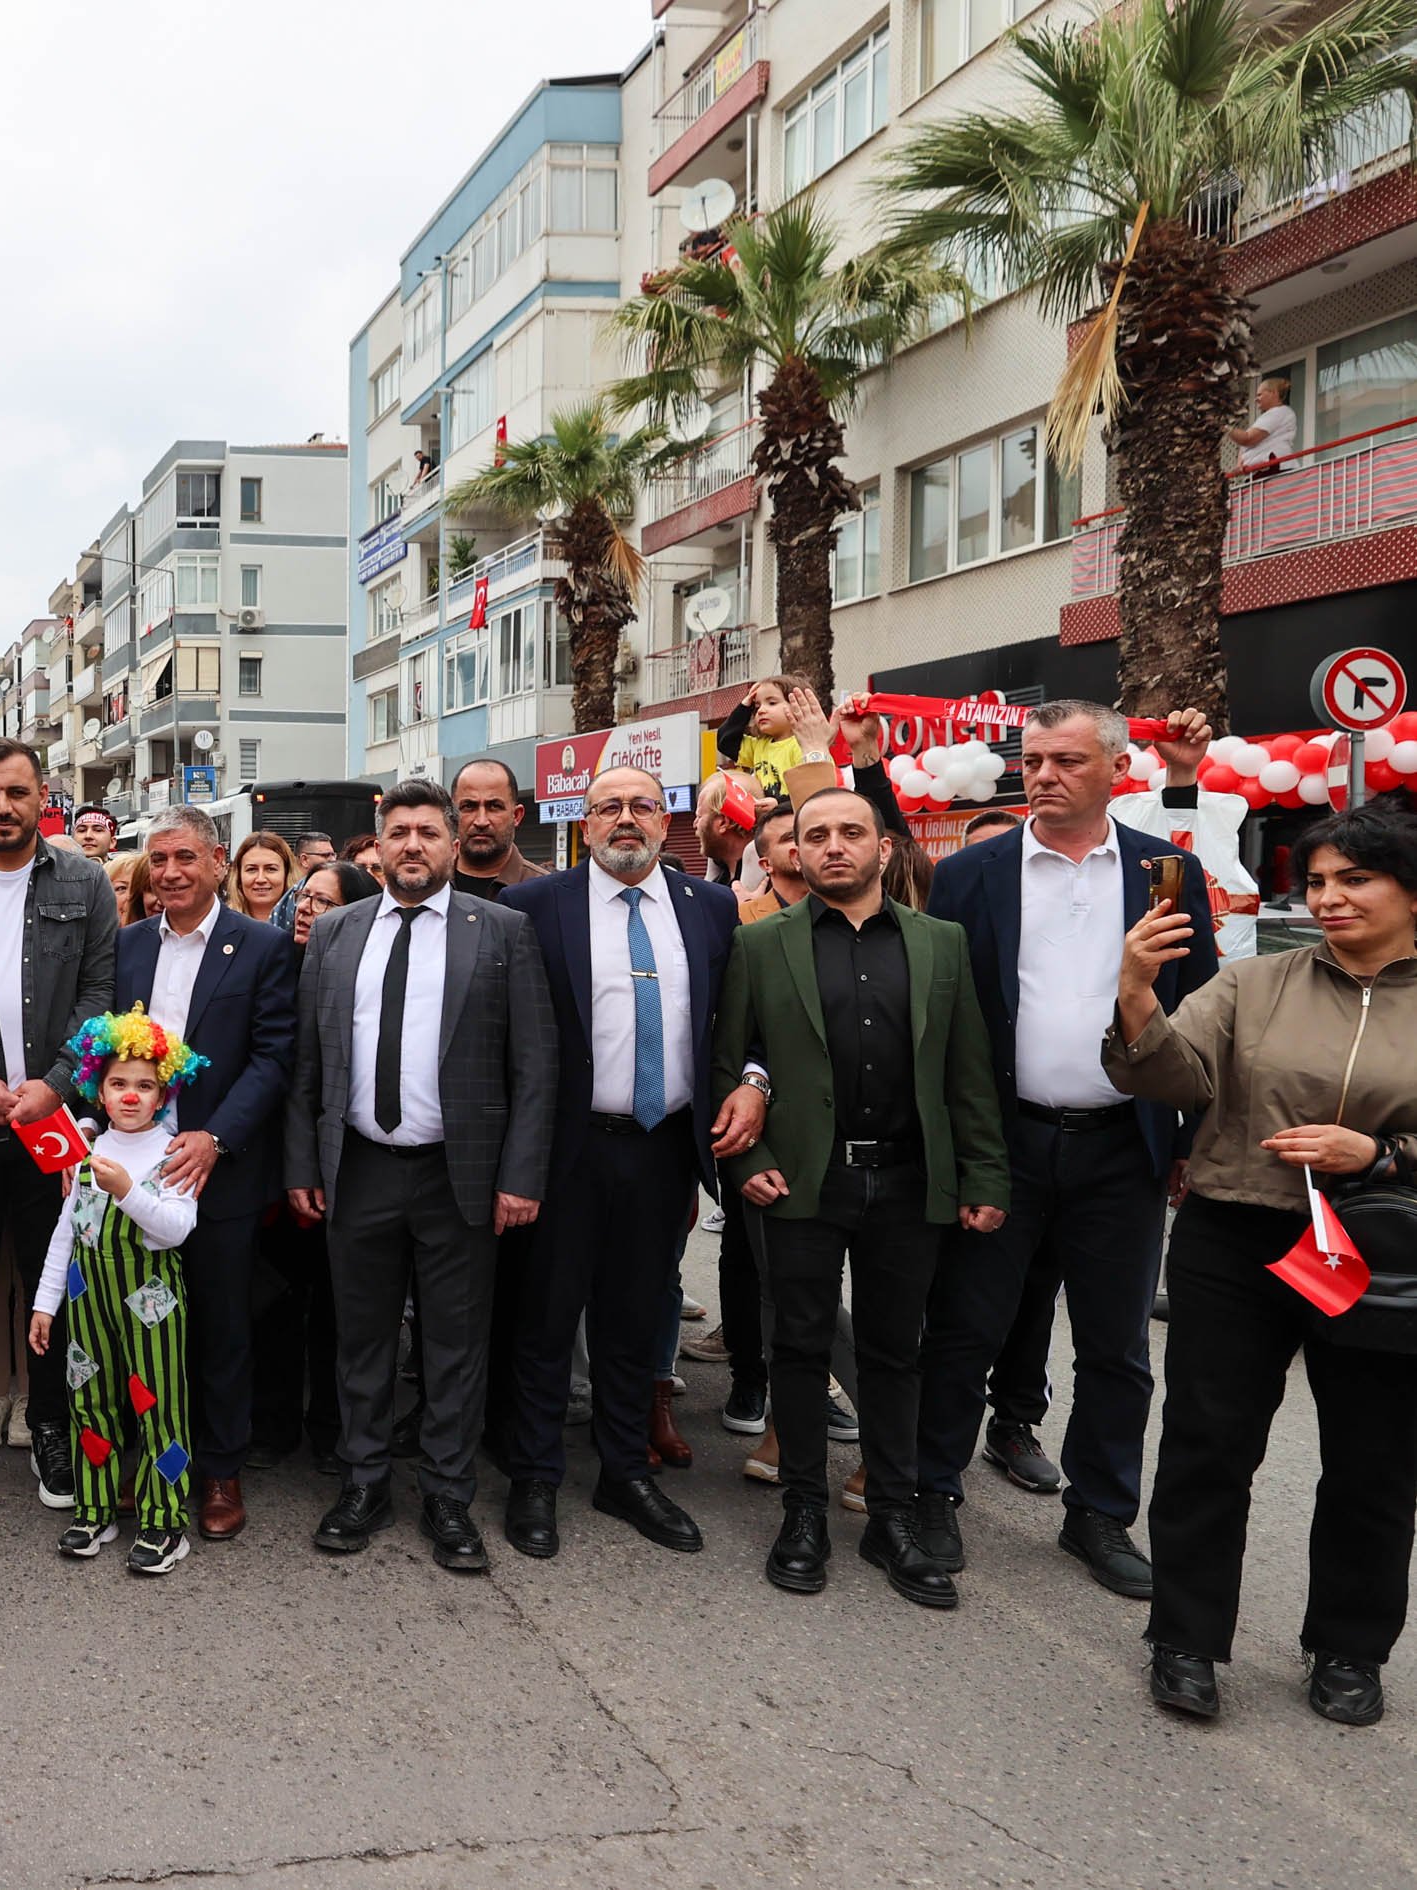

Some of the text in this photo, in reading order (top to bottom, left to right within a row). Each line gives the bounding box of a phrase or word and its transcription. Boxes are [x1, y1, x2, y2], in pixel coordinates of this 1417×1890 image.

[956, 701, 1021, 727] ATAMIZIN
[627, 727, 661, 745] Yeni Nesil
[908, 816, 968, 838] ÜM ÜRÜNLE
